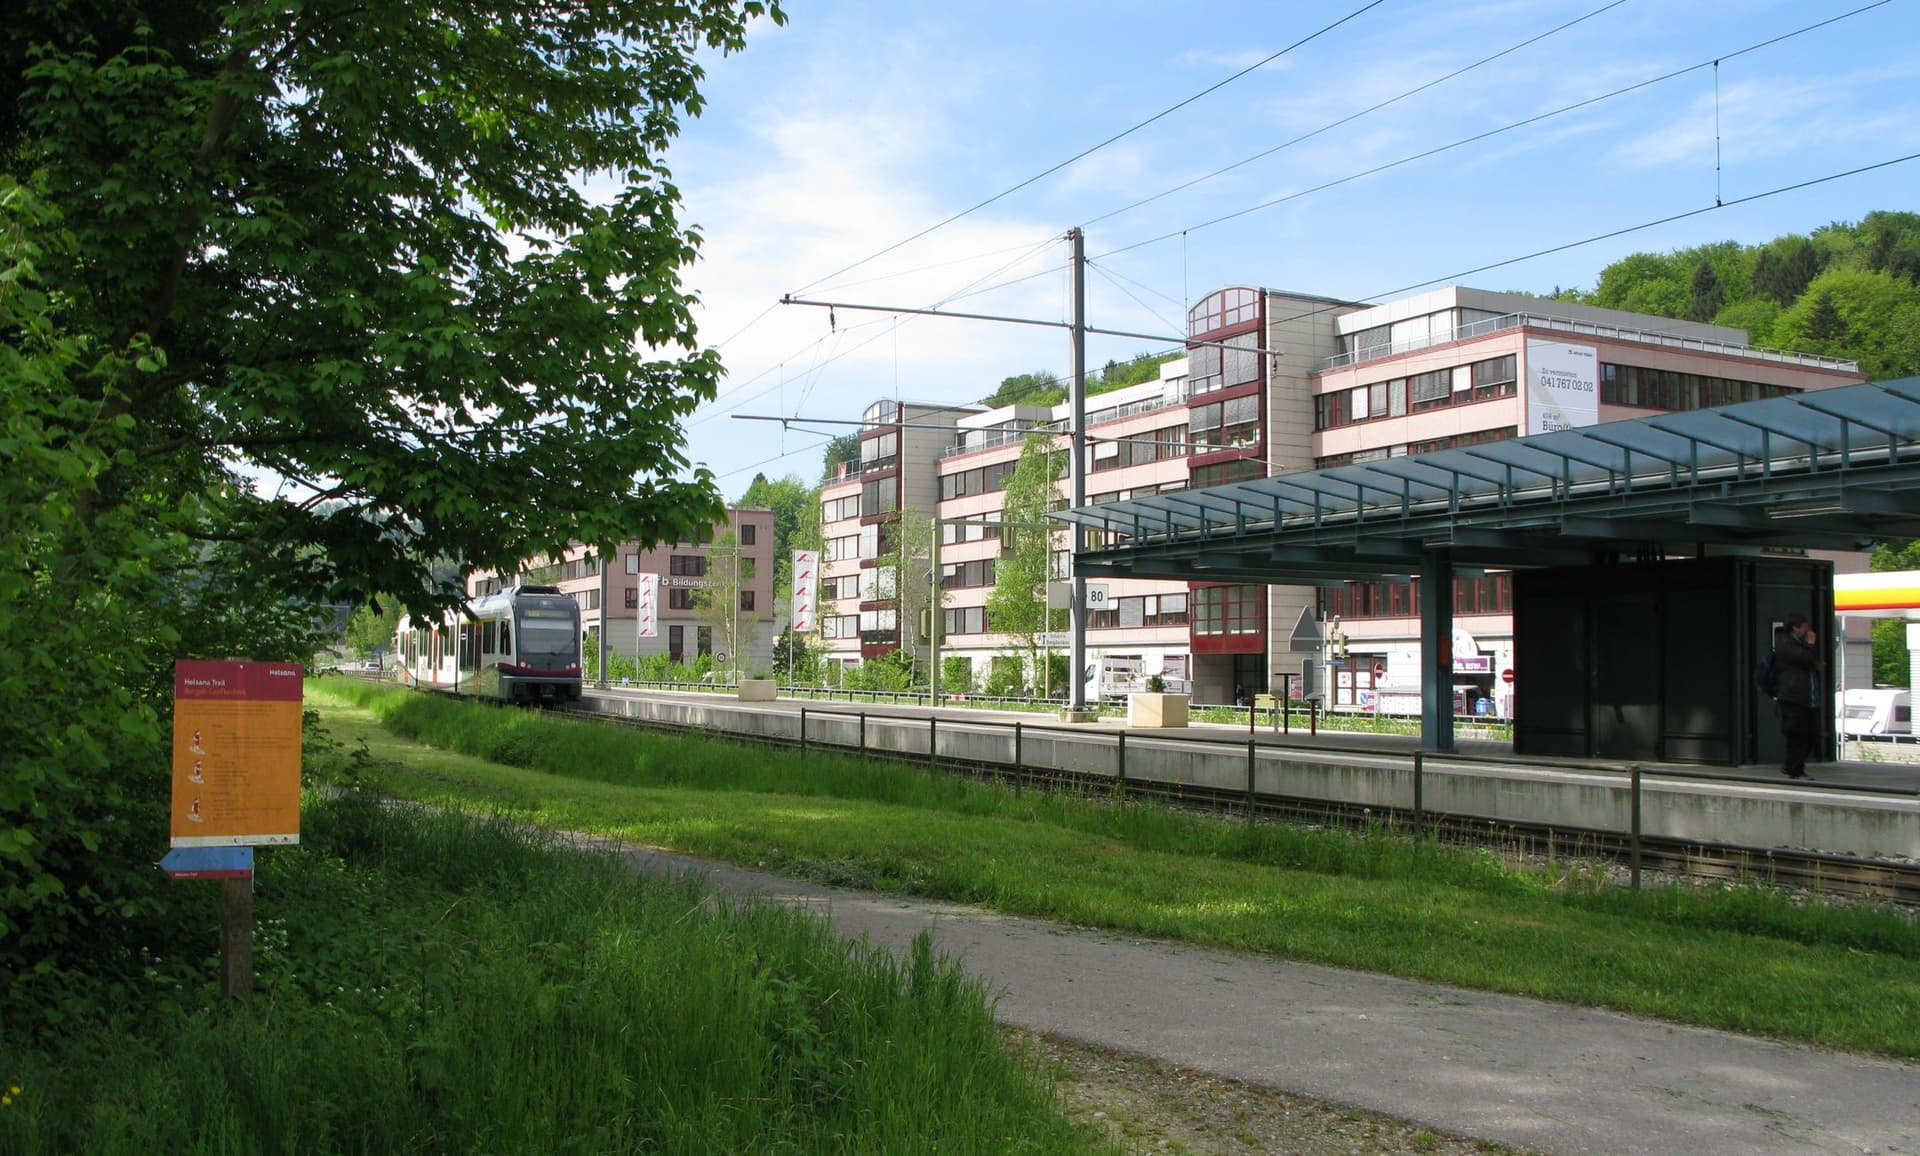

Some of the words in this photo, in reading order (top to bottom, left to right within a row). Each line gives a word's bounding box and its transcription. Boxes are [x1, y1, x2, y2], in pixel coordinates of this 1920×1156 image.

[1541, 376, 1555, 388] 041
[1556, 378, 1571, 390] 767
[1572, 379, 1582, 391] 02
[1583, 381, 1594, 392] 02
[1091, 590, 1104, 602] 80
[269, 669, 297, 677] Helsana
[184, 679, 211, 687] Helsana
[212, 679, 226, 687] Trail
